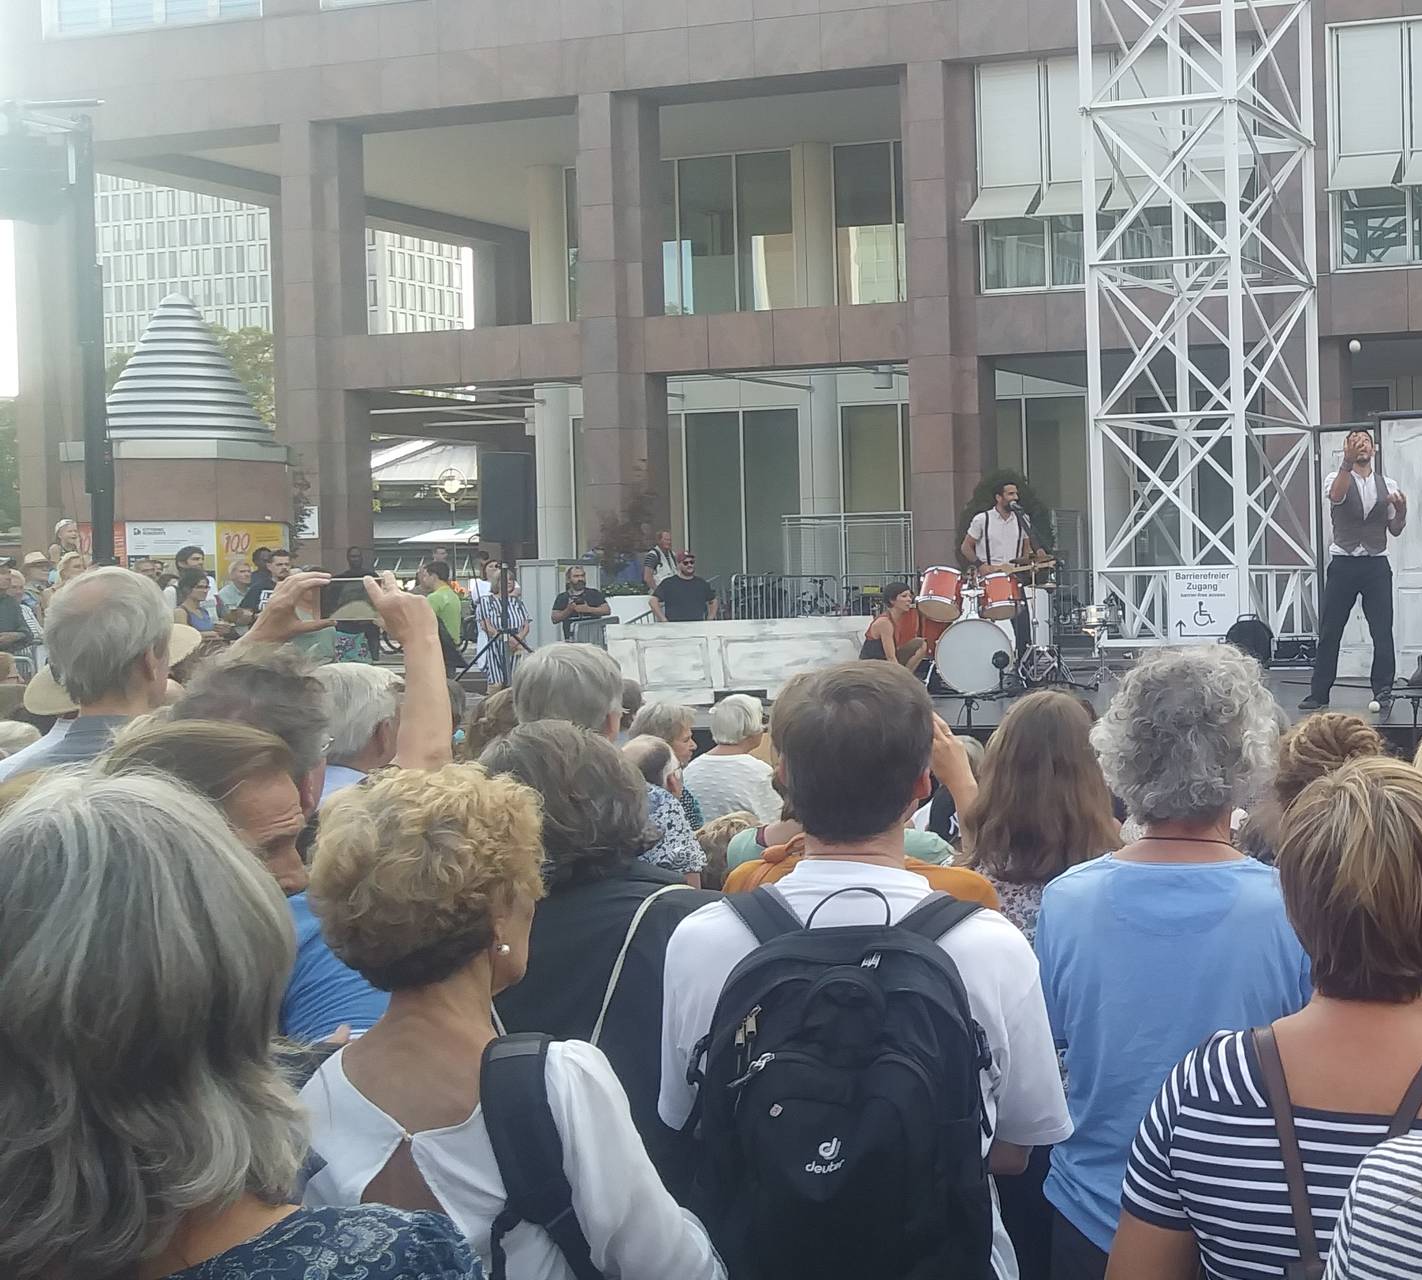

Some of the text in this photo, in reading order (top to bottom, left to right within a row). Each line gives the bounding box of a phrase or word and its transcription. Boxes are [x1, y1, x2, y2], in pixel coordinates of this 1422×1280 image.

[224, 532, 251, 553] 100
[1175, 572, 1230, 580] Barrierefreier
[1186, 582, 1218, 591] Zugang
